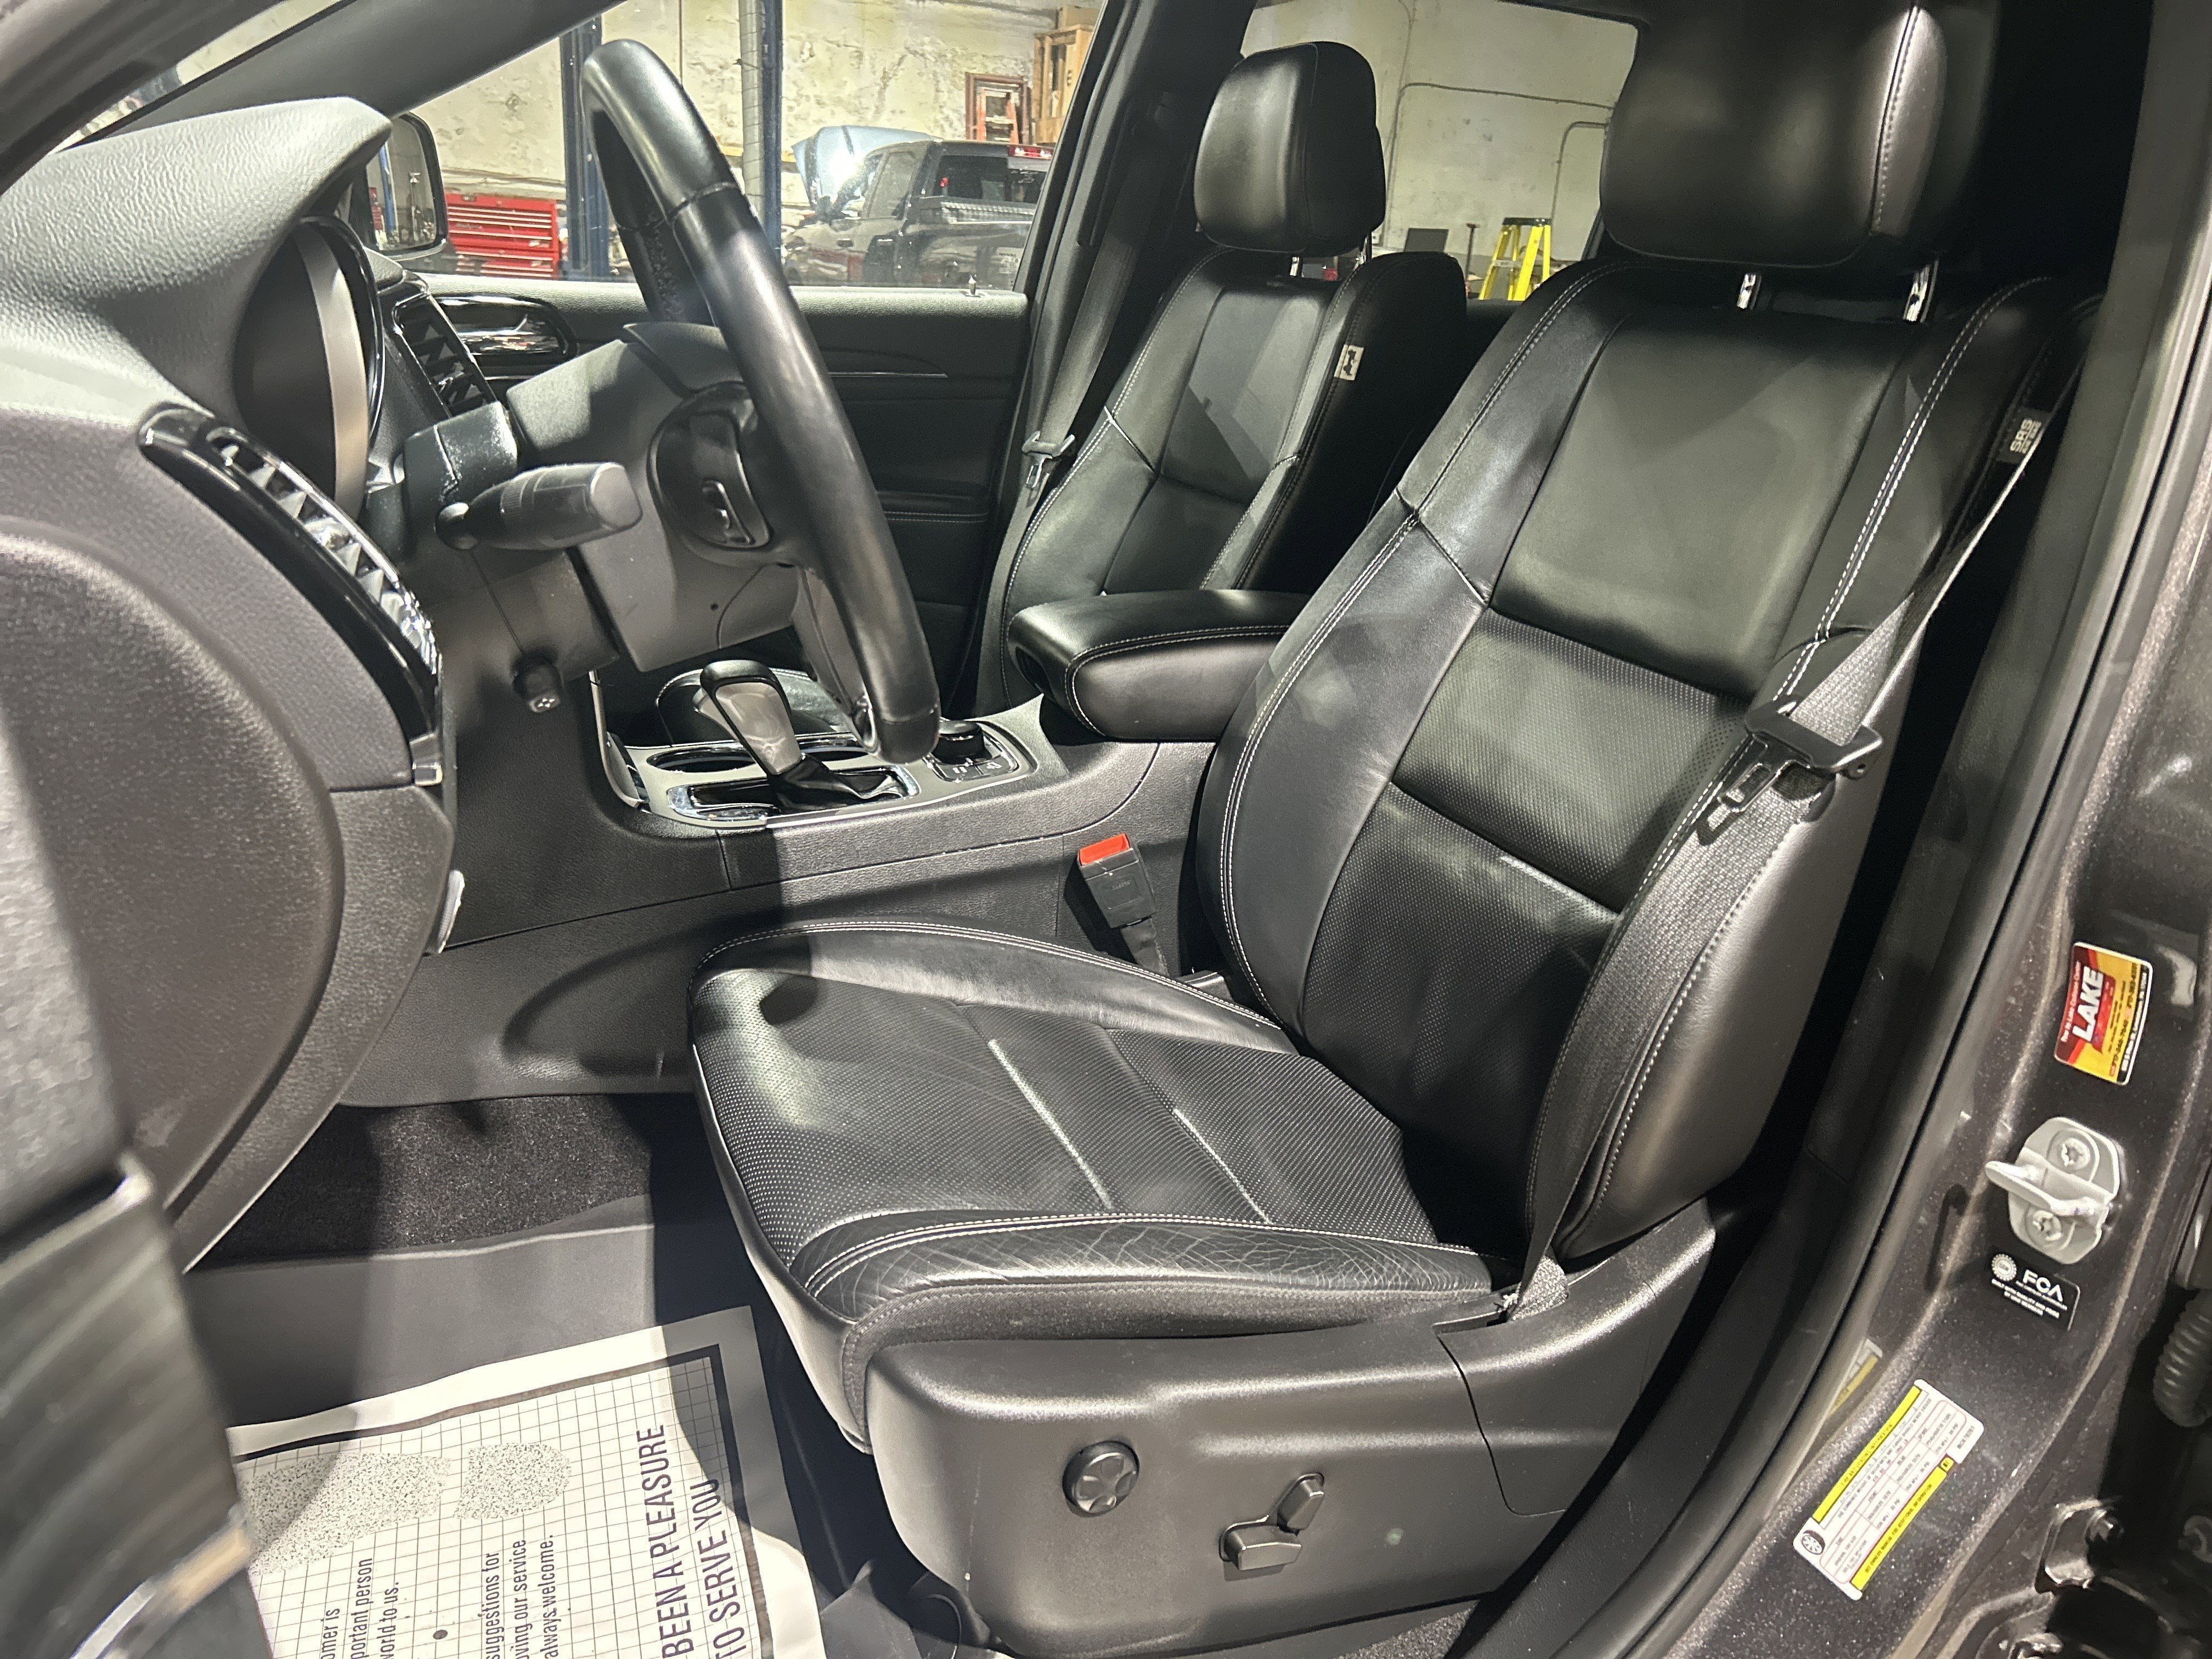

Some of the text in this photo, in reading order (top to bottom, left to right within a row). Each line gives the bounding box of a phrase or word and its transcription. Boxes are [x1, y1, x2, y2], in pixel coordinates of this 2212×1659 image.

[2010, 419, 2033, 453] SRS
[2073, 966, 2104, 1043] LAKE
[2023, 1269, 2063, 1302] FCA
[636, 1425, 695, 1658] BEEN A PLEASURE
[482, 1553, 499, 1572] for
[509, 1539, 527, 1592] service
[690, 1479, 747, 1659] TO SERVE YOU
[356, 1558, 374, 1606] person
[385, 1582, 399, 1604] us.
[538, 1534, 562, 1659] always welcome.
[320, 1608, 340, 1622] is
[379, 1608, 397, 1622] to
[514, 1597, 528, 1620] our
